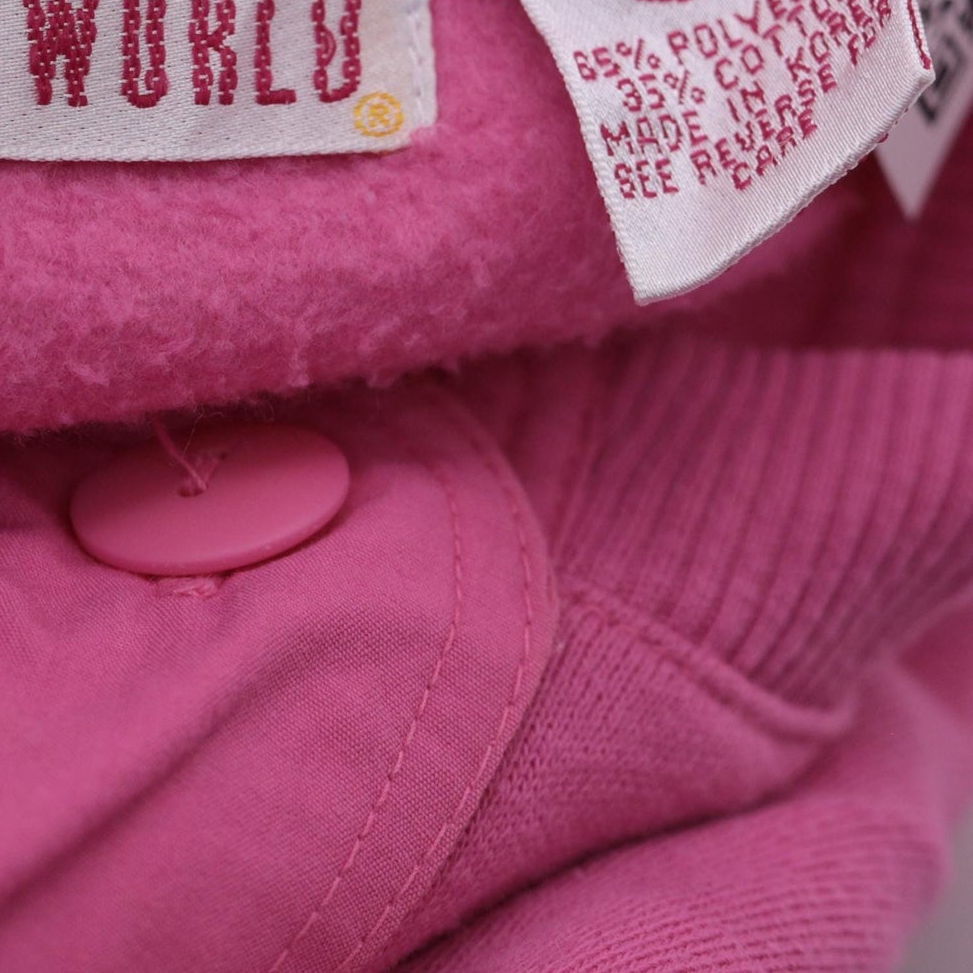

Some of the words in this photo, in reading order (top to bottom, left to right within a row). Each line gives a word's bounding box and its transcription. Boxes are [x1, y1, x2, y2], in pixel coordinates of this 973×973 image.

[573, 37, 661, 82] 65%
[617, 69, 706, 112] 35%
[600, 110, 708, 157] MADE
[726, 80, 767, 123] IN
[614, 158, 680, 199] SEE
[690, 63, 838, 186] REVERSE
[731, 108, 819, 191] CARE
